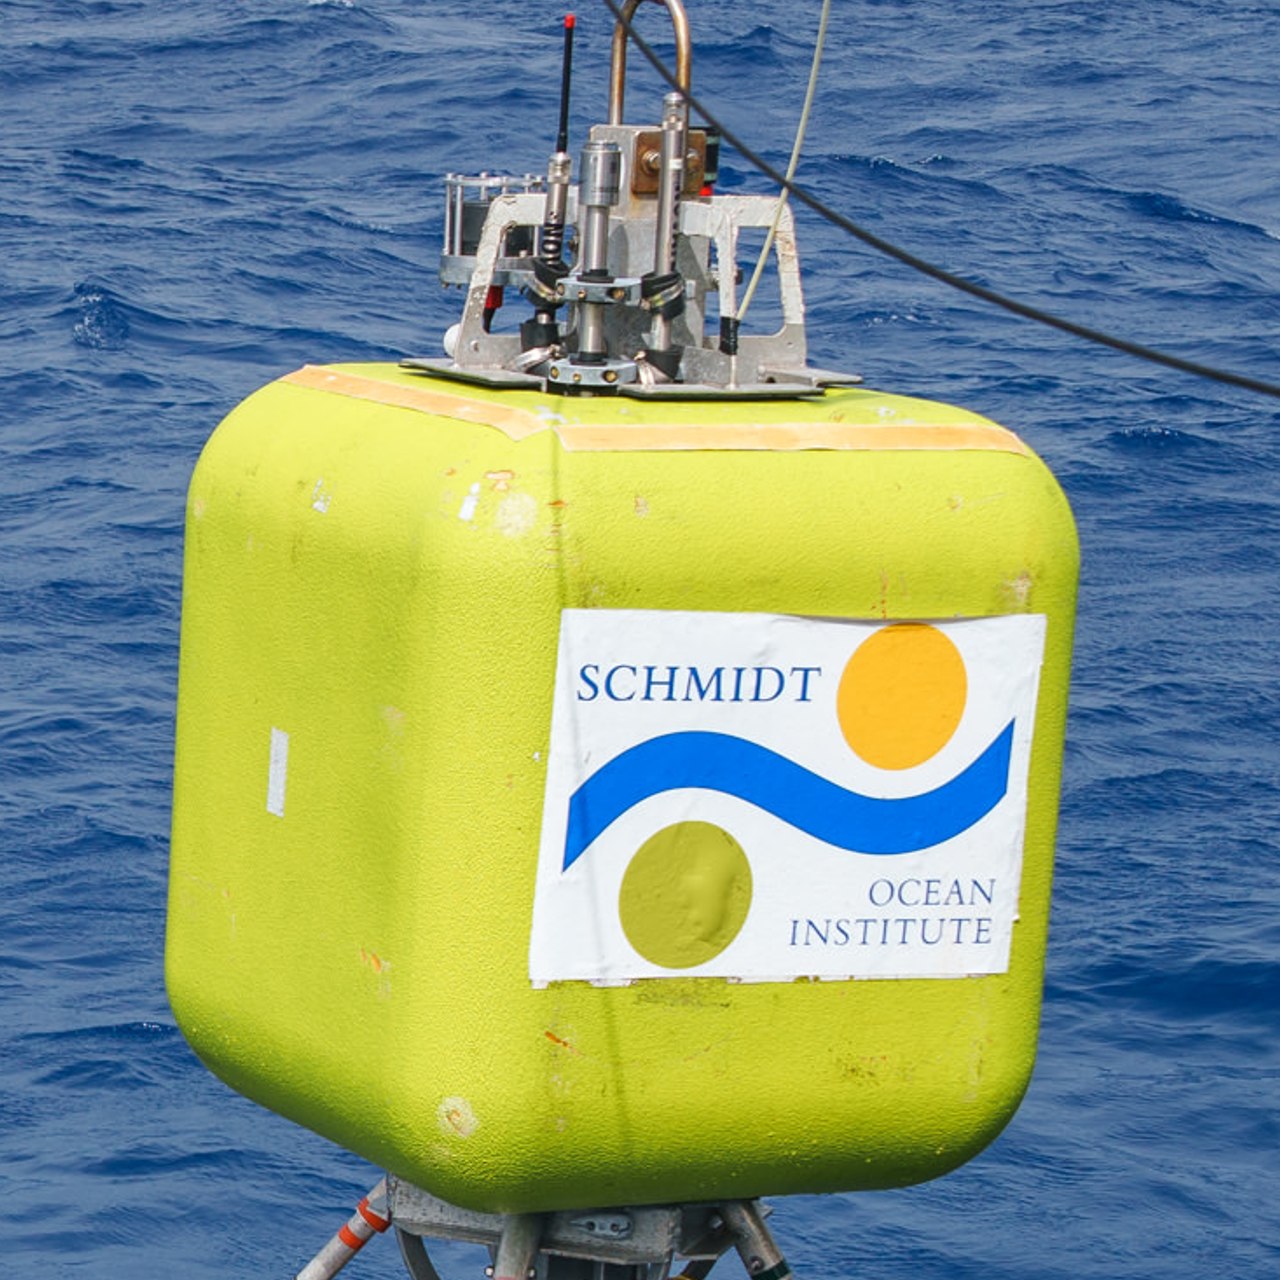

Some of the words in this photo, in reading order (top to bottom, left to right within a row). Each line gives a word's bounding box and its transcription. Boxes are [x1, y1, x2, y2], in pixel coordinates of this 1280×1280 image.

[577, 664, 822, 702] SCHMIDT
[869, 878, 996, 907] OCEAN
[789, 918, 992, 945] INSTITUTE
